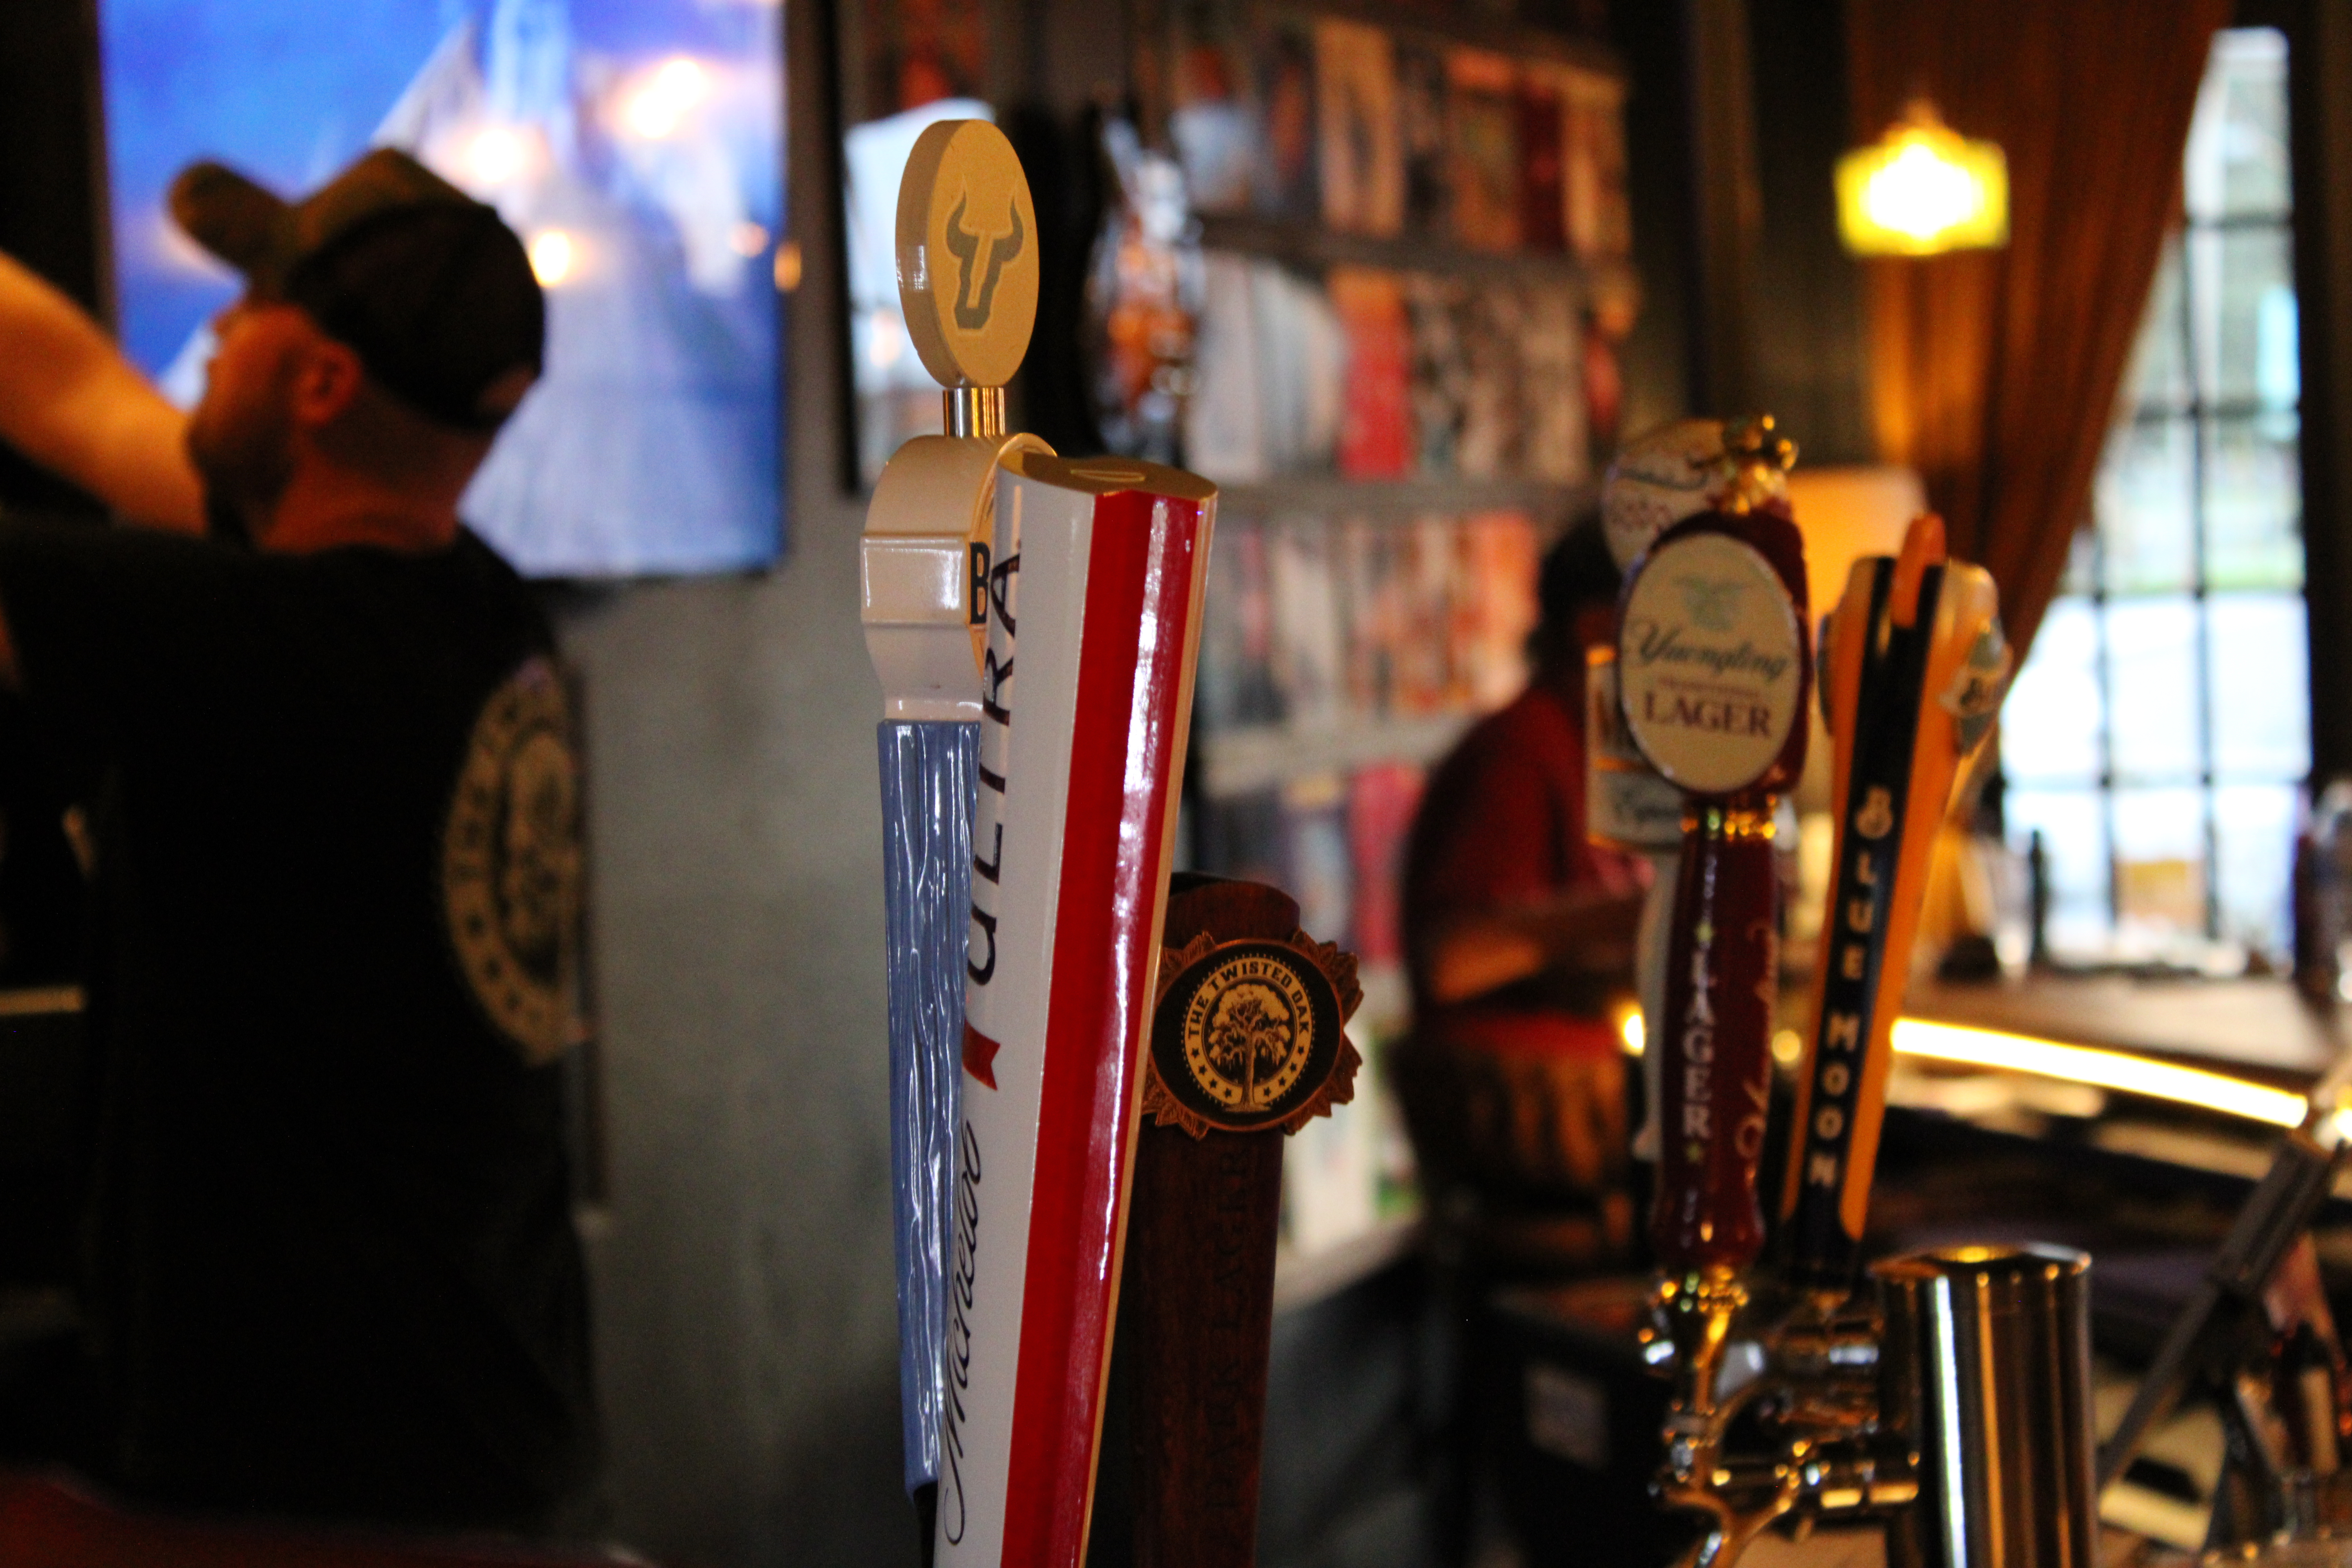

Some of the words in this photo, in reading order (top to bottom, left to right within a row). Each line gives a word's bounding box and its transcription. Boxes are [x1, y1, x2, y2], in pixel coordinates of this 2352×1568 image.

[1639, 624, 1789, 684] Yuengling
[1645, 691, 1772, 738] LAGER
[1843, 786, 1893, 980] BLUE
[1188, 996, 1209, 1036] THE
[1210, 961, 1292, 991] TWISTED
[1292, 989, 1310, 1033] OAK
[1682, 947, 1717, 1139] LAGER
[1808, 1011, 1860, 1188] MOON
